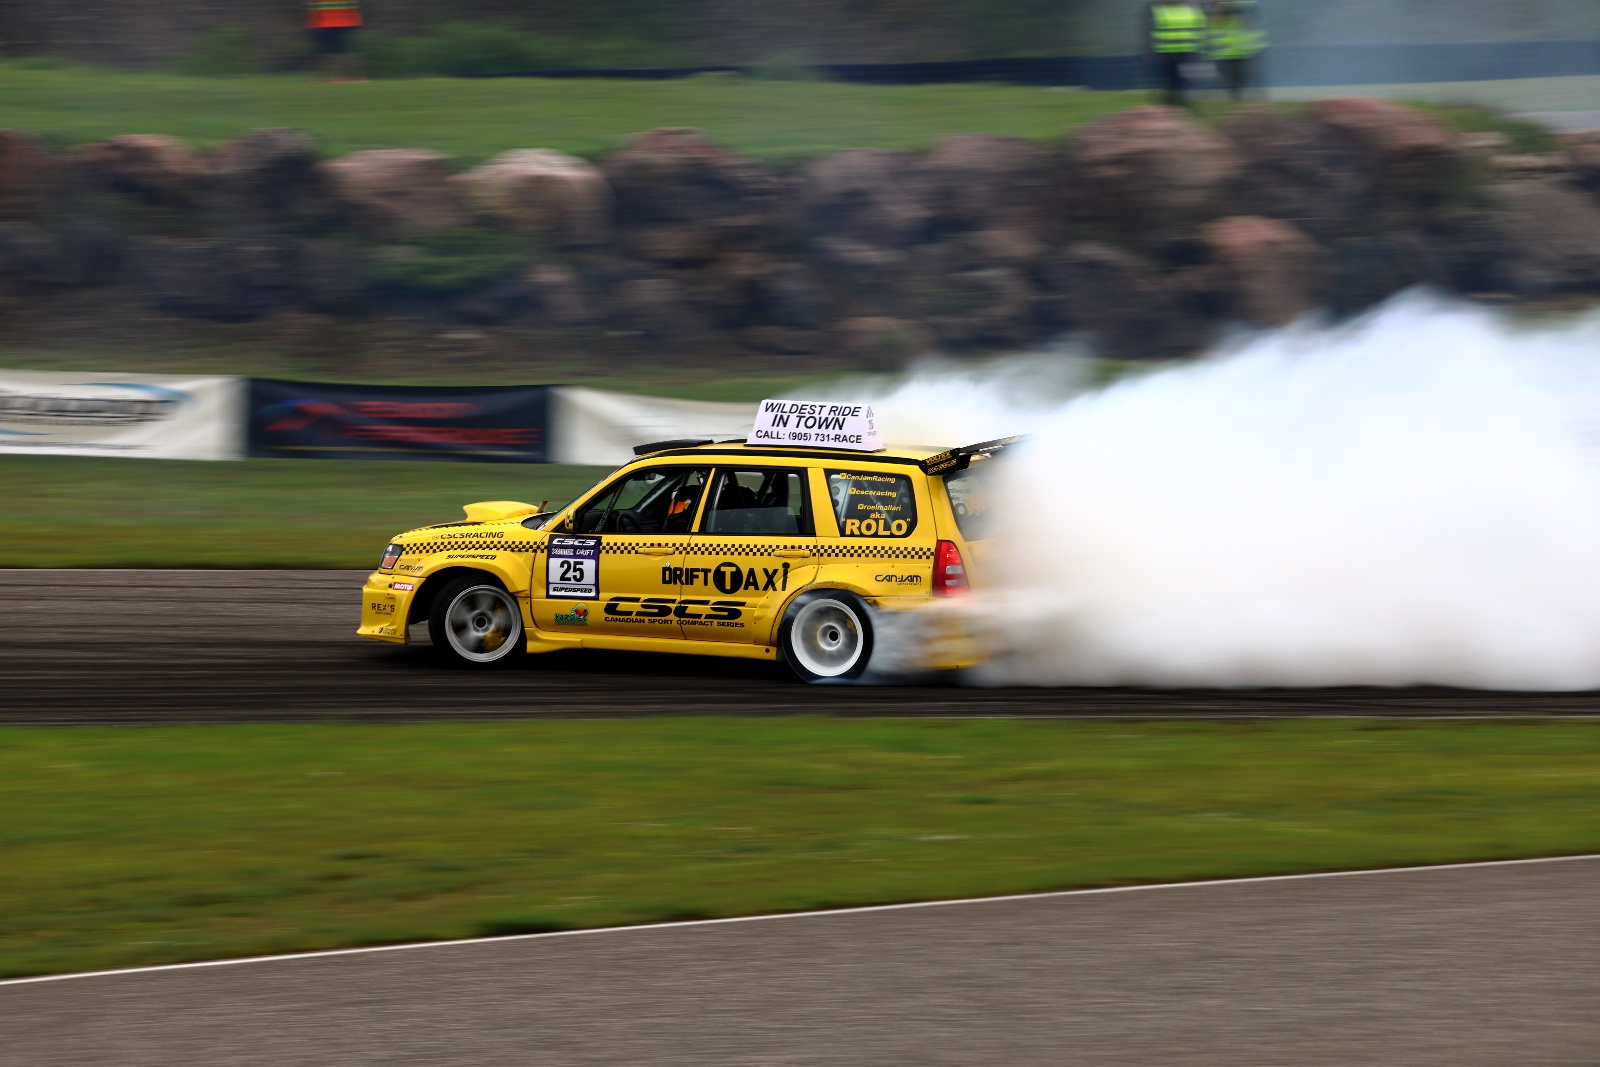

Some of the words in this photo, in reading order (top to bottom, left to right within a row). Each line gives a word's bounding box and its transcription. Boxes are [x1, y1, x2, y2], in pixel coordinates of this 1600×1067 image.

[765, 402, 826, 415] WILDEST
[828, 406, 861, 416] RIDE
[771, 413, 791, 428] IN
[795, 415, 846, 431] TOWN
[755, 429, 785, 440] CALL:
[788, 431, 812, 441] (905)
[814, 433, 862, 443] 731-RACE
[869, 511, 886, 519] aka
[552, 537, 598, 546] CSCS
[559, 560, 584, 582] 25
[661, 566, 712, 587] DRIFT
[552, 586, 593, 594] SUPERSPEED
[371, 602, 396, 612] REX'S
[603, 596, 747, 620] CSCS
[604, 616, 646, 624] CANADIAN
[676, 619, 714, 627] COMPACT
